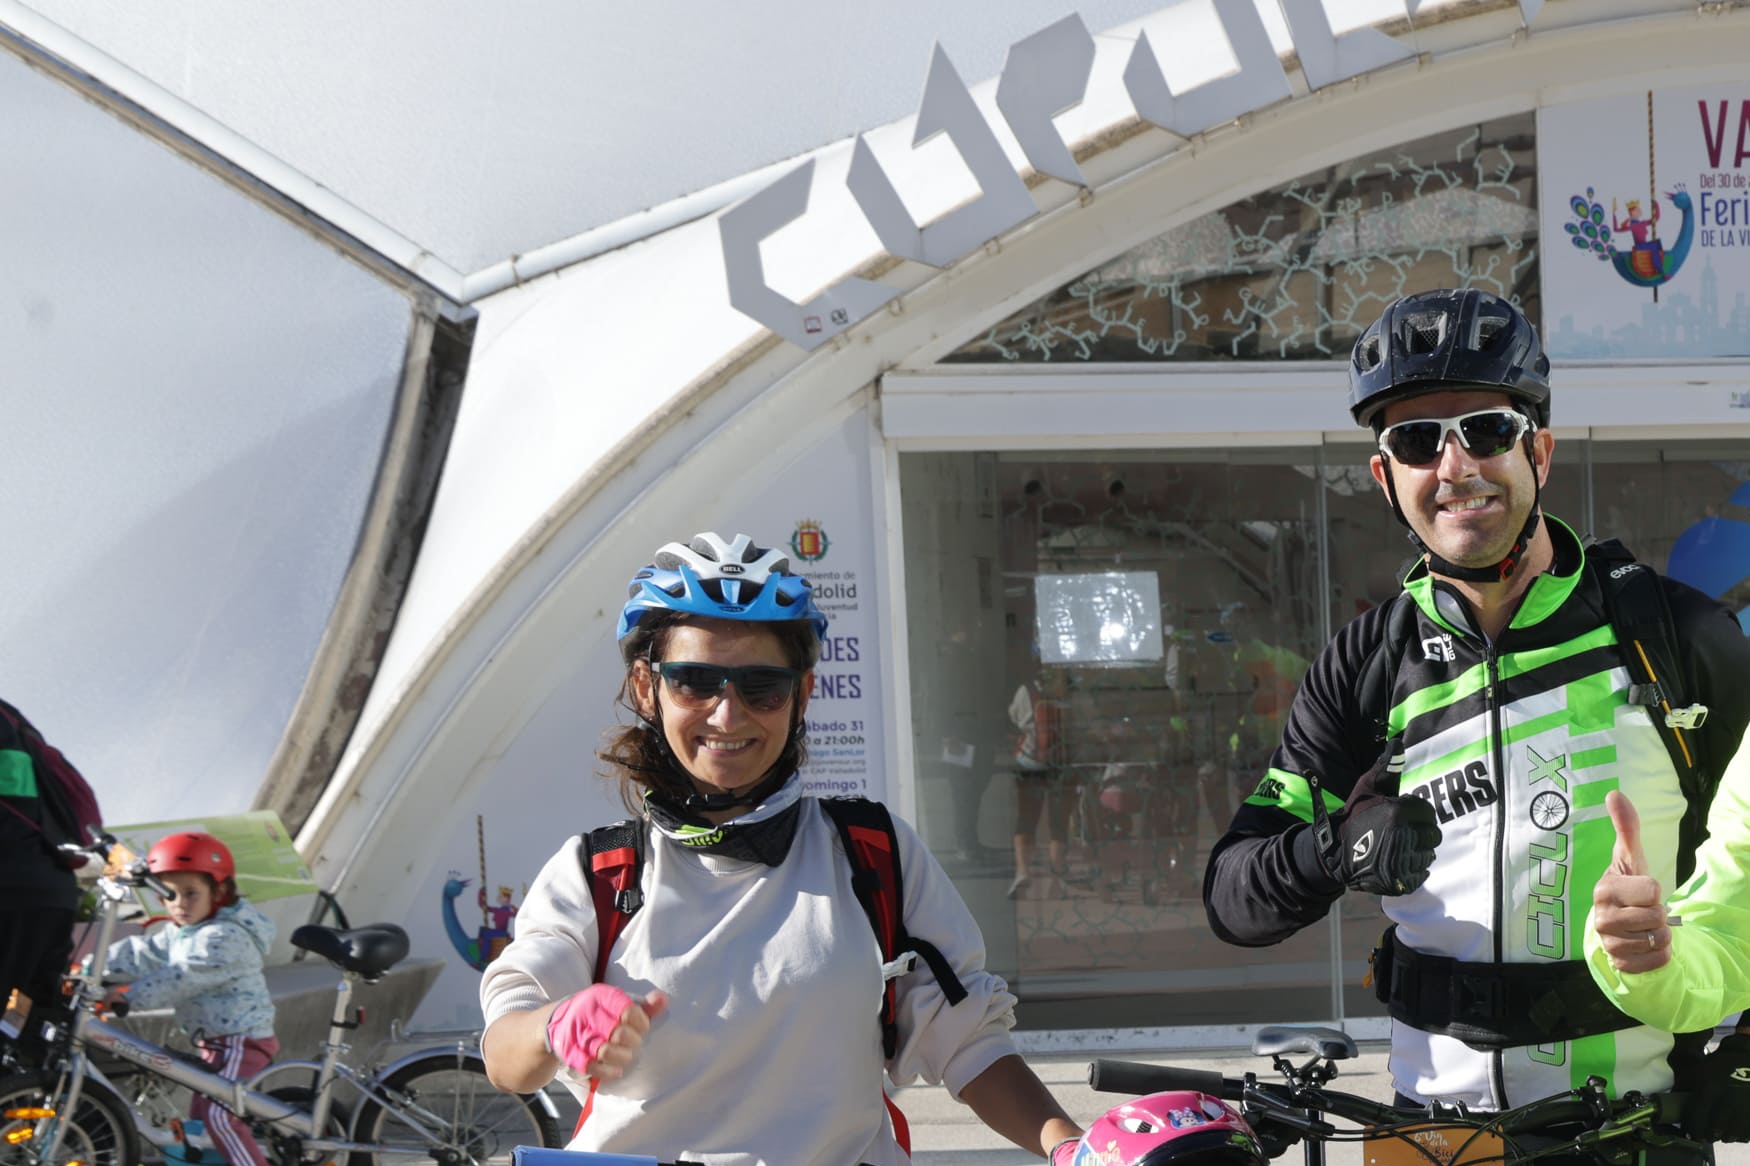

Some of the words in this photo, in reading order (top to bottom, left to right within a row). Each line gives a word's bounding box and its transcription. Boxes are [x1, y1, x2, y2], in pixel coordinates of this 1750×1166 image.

[1700, 173, 1716, 188] Del
[1718, 173, 1731, 188] 30
[1733, 173, 1747, 188] de
[1701, 230, 1716, 247] DE
[1720, 230, 1735, 247] LA
